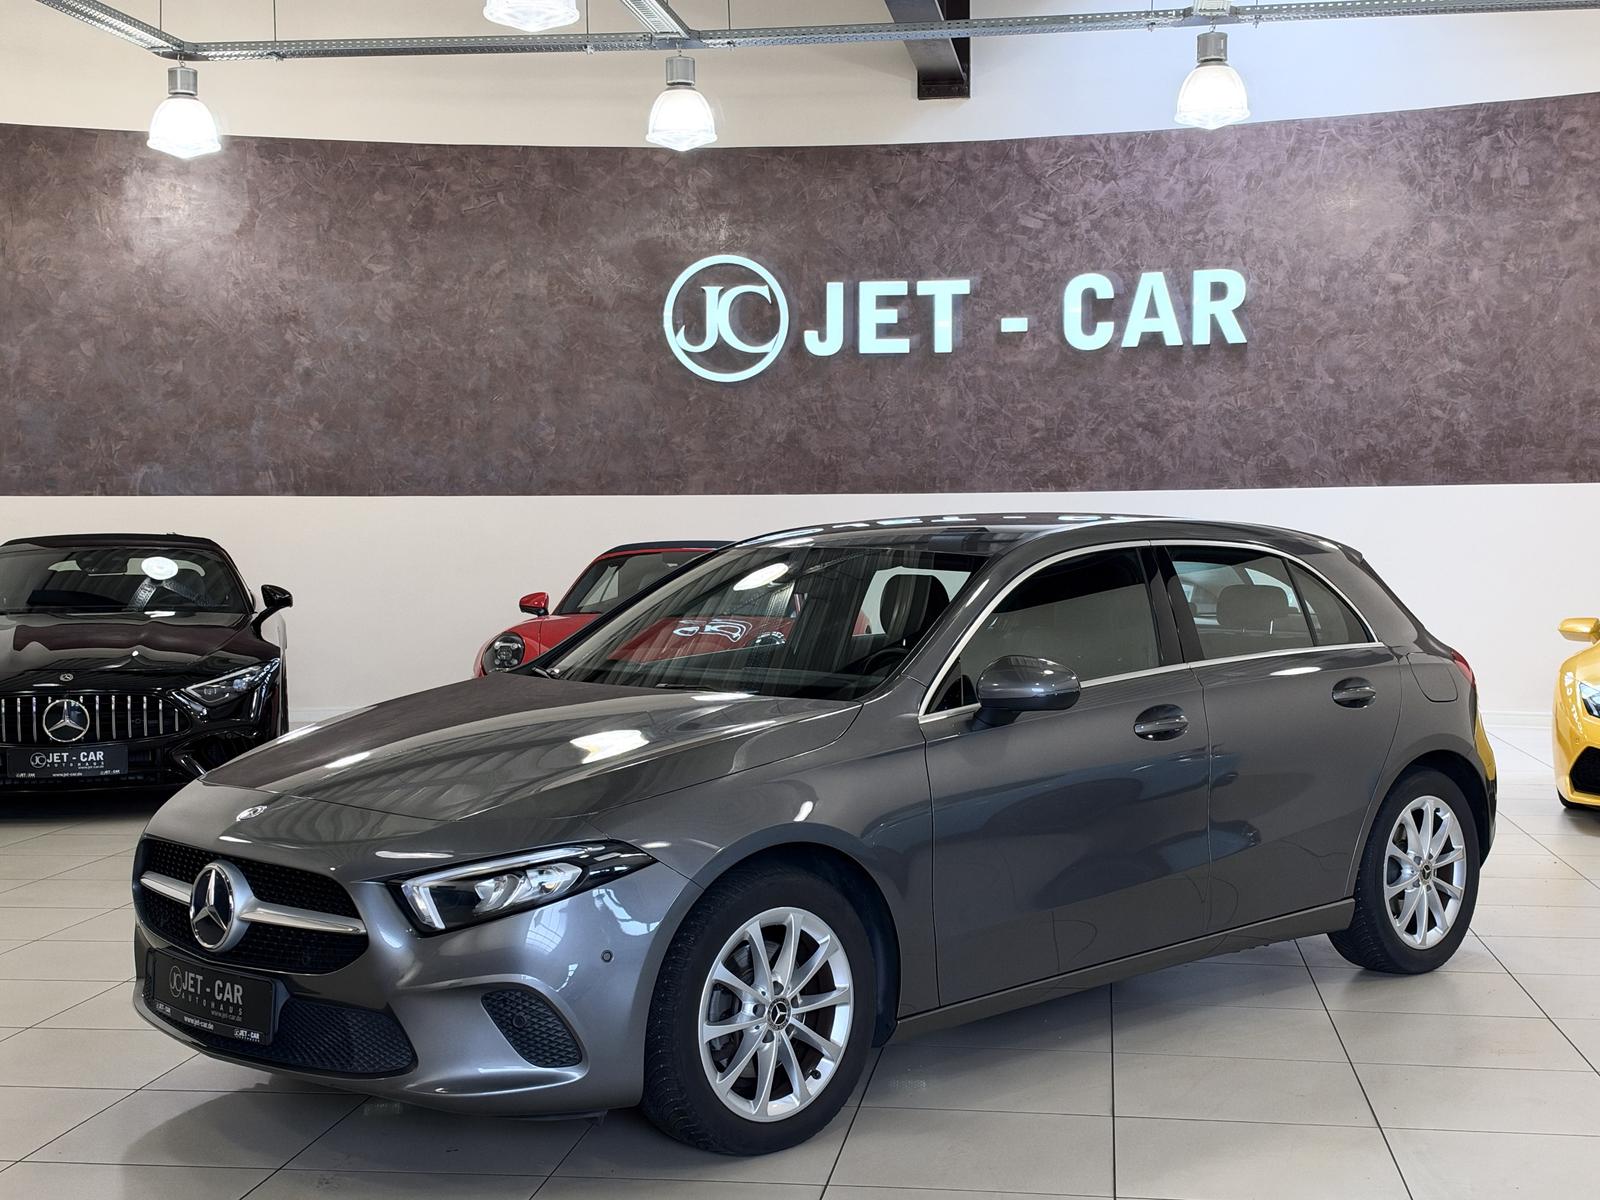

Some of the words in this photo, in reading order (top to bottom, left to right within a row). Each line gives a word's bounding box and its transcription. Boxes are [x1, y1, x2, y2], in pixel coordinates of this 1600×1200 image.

[803, 279, 971, 357] JET
[1000, 317, 1029, 333] -
[1062, 268, 1248, 351] CAR
[47, 752, 69, 763] JET
[80, 751, 104, 762] CAR
[182, 970, 203, 995] JET
[214, 979, 243, 1006] CAR
[182, 992, 243, 1016] AUTOHAUS
[250, 1031, 260, 1040] CAR
